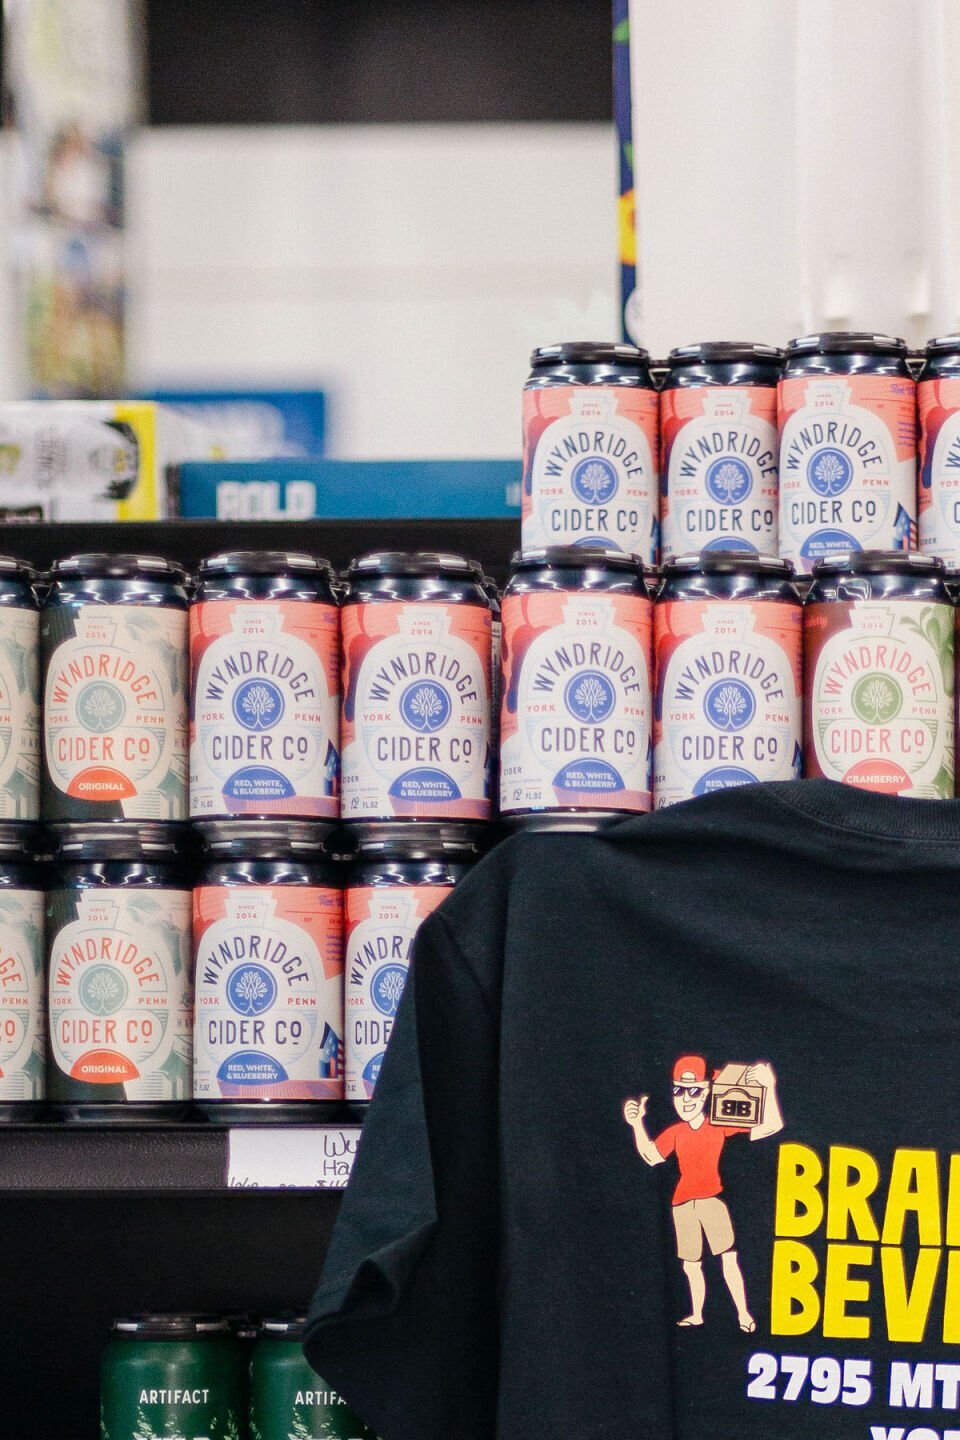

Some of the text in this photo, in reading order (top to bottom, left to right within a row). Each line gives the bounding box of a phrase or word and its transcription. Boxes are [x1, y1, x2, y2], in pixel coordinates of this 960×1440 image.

[544, 431, 643, 480] WYNDRIDGE
[679, 431, 779, 480] WYNDRIDGE
[786, 421, 883, 470] WYNDRIDGE
[791, 500, 842, 525] CIDER
[52, 654, 157, 705] WYNDRIDGE
[204, 650, 315, 703] WYNDRIDGE
[368, 651, 477, 705] WYNDRIDGE
[533, 642, 641, 697] WYNDRIDGE
[674, 649, 784, 704] WYNDRIDGE
[823, 645, 931, 698] WYNDRIDGE
[527, 704, 645, 717] YORK PENN
[58, 736, 114, 762] CIDER
[377, 736, 441, 762] CIDER
[541, 727, 605, 753] CIDER
[78, 781, 126, 792] ORIGINAL
[572, 779, 617, 788] BLUEBERRY
[846, 775, 906, 784] CRANBERRY
[56, 936, 160, 987] WYNDRIDGE
[203, 935, 310, 987] WYNDRIDGE
[62, 1019, 117, 1044] CIDER
[81, 1065, 128, 1074] ORIGINAL
[139, 1388, 209, 1405] ARTIFACT
[747, 1354, 872, 1406] 2795
